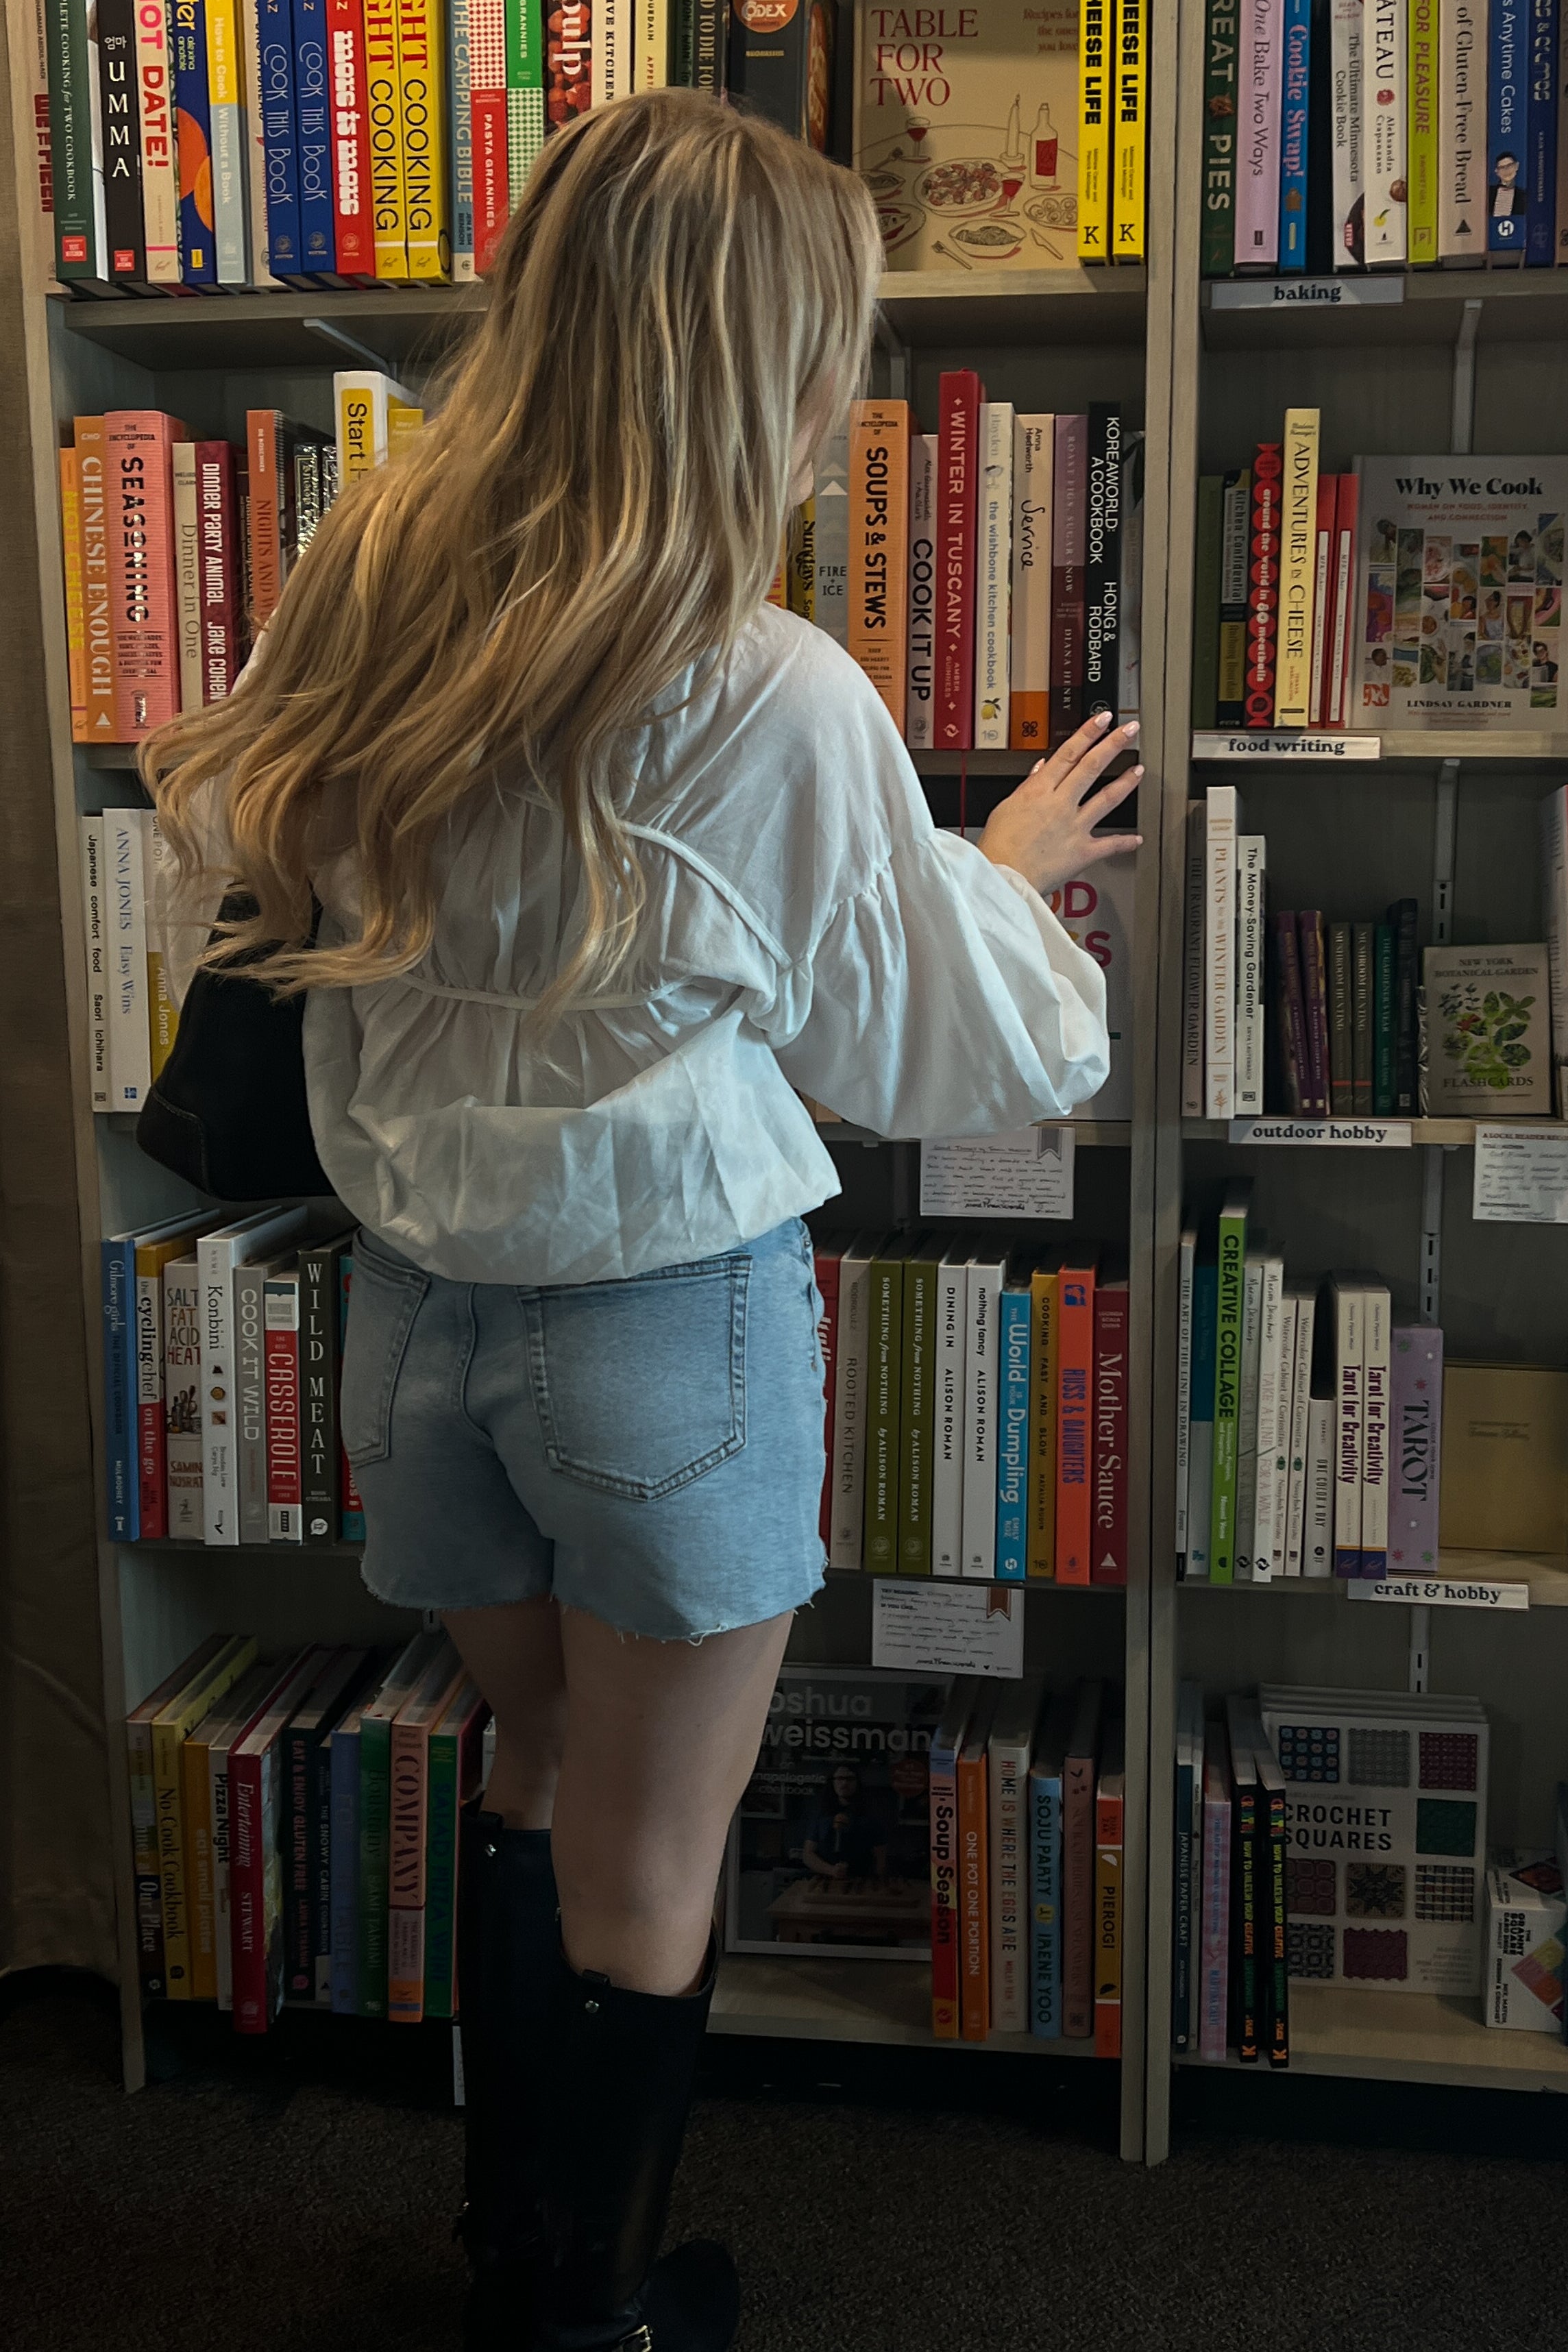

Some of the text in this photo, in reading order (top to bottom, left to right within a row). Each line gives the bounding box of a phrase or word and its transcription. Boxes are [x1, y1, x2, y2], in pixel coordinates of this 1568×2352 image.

[214, 17, 225, 47] How
[215, 49, 224, 62] to
[870, 8, 979, 38] TABLE
[876, 43, 944, 73] FOR
[215, 64, 228, 99] Cook
[605, 31, 615, 101] KITCHEN
[870, 77, 951, 107] TWO
[1499, 12, 1517, 134] Anytime Cakes
[108, 61, 130, 178] UMMA
[218, 108, 231, 160] Without
[263, 43, 293, 205] COOK THIS BOOK
[299, 41, 327, 202] COOK THIS BOOK
[1335, 70, 1347, 148] Cookie Book
[1375, 114, 1384, 175] Crapanzano
[1386, 116, 1395, 172] Aleksandra
[221, 172, 232, 204] Book
[484, 113, 495, 228] PASTA GRANNIES
[1083, 225, 1101, 245] K
[1118, 223, 1136, 242] K
[1273, 284, 1342, 303] baking
[346, 402, 368, 462] Start
[1034, 427, 1043, 451] Anna
[1105, 416, 1120, 533] KOREAWORLD:
[1395, 478, 1543, 500] Why We Cook
[121, 456, 149, 624] SEASONING
[864, 446, 889, 629] SOUPS & STEWS
[946, 411, 967, 639] WINTER IN TUSCANY
[81, 456, 112, 696] CHINESE ENOUGH
[819, 565, 847, 577] FIRE
[822, 585, 844, 596] ICE
[985, 500, 1000, 689] the wishbone kitchen cookbook
[911, 538, 933, 701] COOK IT UP
[1087, 605, 1103, 683] RODBARD
[1407, 699, 1512, 709] LINDSAY GARDNER
[1228, 738, 1346, 756] food writing
[88, 834, 102, 973] Japanese comfort food
[1244, 847, 1258, 1020] The Money-Saving Gardener
[1443, 1076, 1534, 1088] FLASHCARDS
[1252, 1123, 1388, 1143] outdoor hobby
[167, 1286, 199, 1307] SALT
[171, 1307, 197, 1326] FAT
[207, 1285, 225, 1350] Konbini
[945, 1286, 955, 1348] DINING IN
[975, 1286, 988, 1356] nothing fancy
[1218, 1234, 1240, 1417] CREATIVE COLLAGE
[169, 1326, 199, 1346] ACID
[138, 1281, 158, 1475] the cyclingchef on the go
[268, 1353, 297, 1480] CASSEROLE
[943, 1368, 953, 1460] ALISON ROMAN
[976, 1369, 985, 1462] ALISON ROMAN
[1277, 1316, 1293, 1447] Watercolor Cabinet of Curiosities
[1293, 1316, 1310, 1448] Watercolor Cabinet of Curiosities
[841, 1357, 857, 1494] ROOTED KITCHEN
[999, 1408, 1027, 1504] Dumpling
[1062, 1369, 1086, 1485] RUSS & DAUGHTERS
[1097, 1351, 1123, 1529] Mother Sauce
[1338, 1364, 1362, 1484] Tarot for Creativity
[1362, 1364, 1386, 1486] Tarot for Creativity
[1401, 1399, 1429, 1502] TAROT
[1374, 1582, 1502, 1604] craft & hobby
[214, 1773, 230, 1863] Pizza Night
[393, 1754, 419, 1900] COMPANY
[1037, 1794, 1053, 1896] SOJU PARTY
[1284, 1803, 1393, 1828] CROCHET
[1284, 1828, 1393, 1850] SQUARES
[319, 1805, 329, 1955] THE SNOWY CABIN COOKBOOK
[934, 1805, 955, 1945] Soup Season
[1001, 1760, 1018, 1951] HOME IS WHERE THE EGGS ARE
[1179, 1831, 1191, 1948] JAPANESE PAPER CRAFT
[139, 1881, 160, 1953] Our Place
[966, 1830, 981, 1976] ONE POT ONE PORTION
[1102, 1885, 1116, 1950] PIEROGI
[1517, 1912, 1526, 1957] GRANNY
